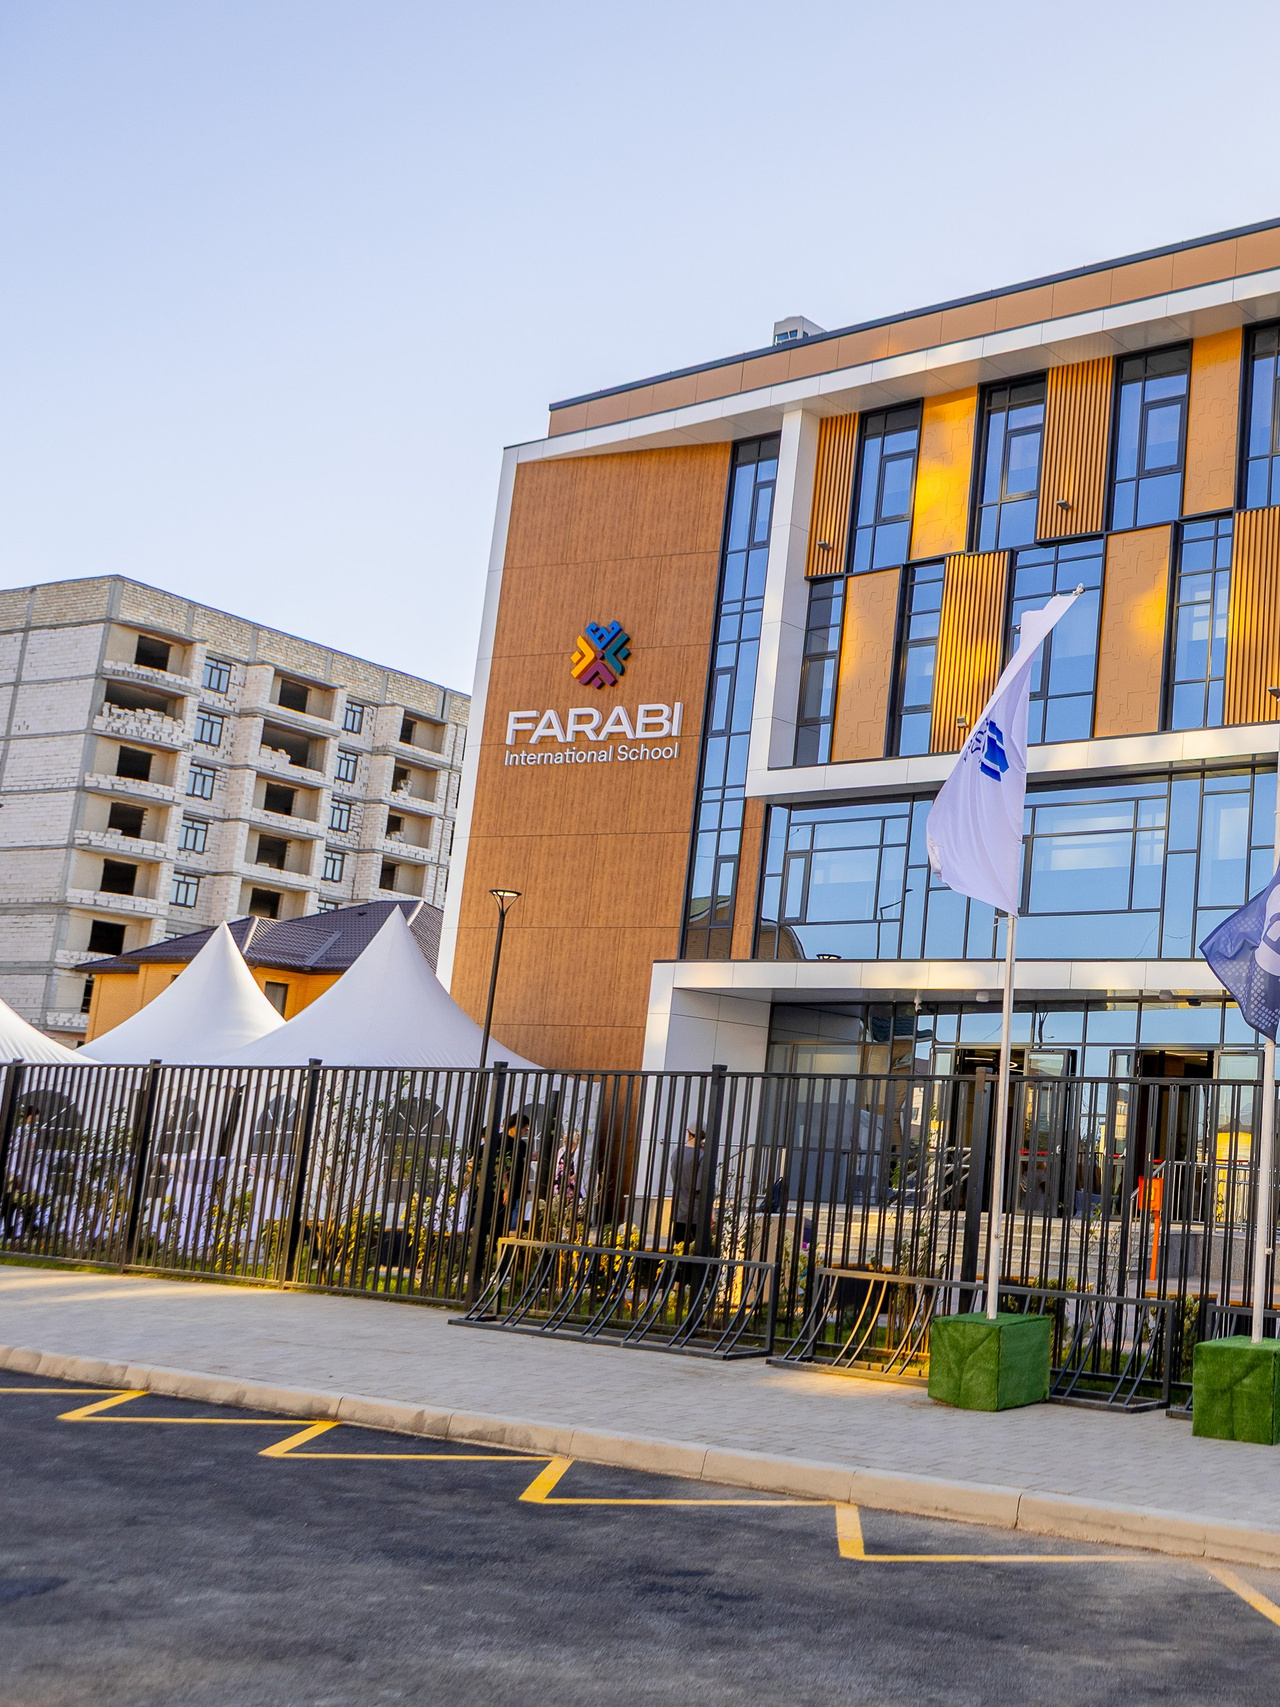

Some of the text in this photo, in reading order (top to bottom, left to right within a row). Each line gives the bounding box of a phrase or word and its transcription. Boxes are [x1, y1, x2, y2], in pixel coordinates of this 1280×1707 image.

[505, 702, 683, 745] FARABI
[504, 742, 679, 766] International School
